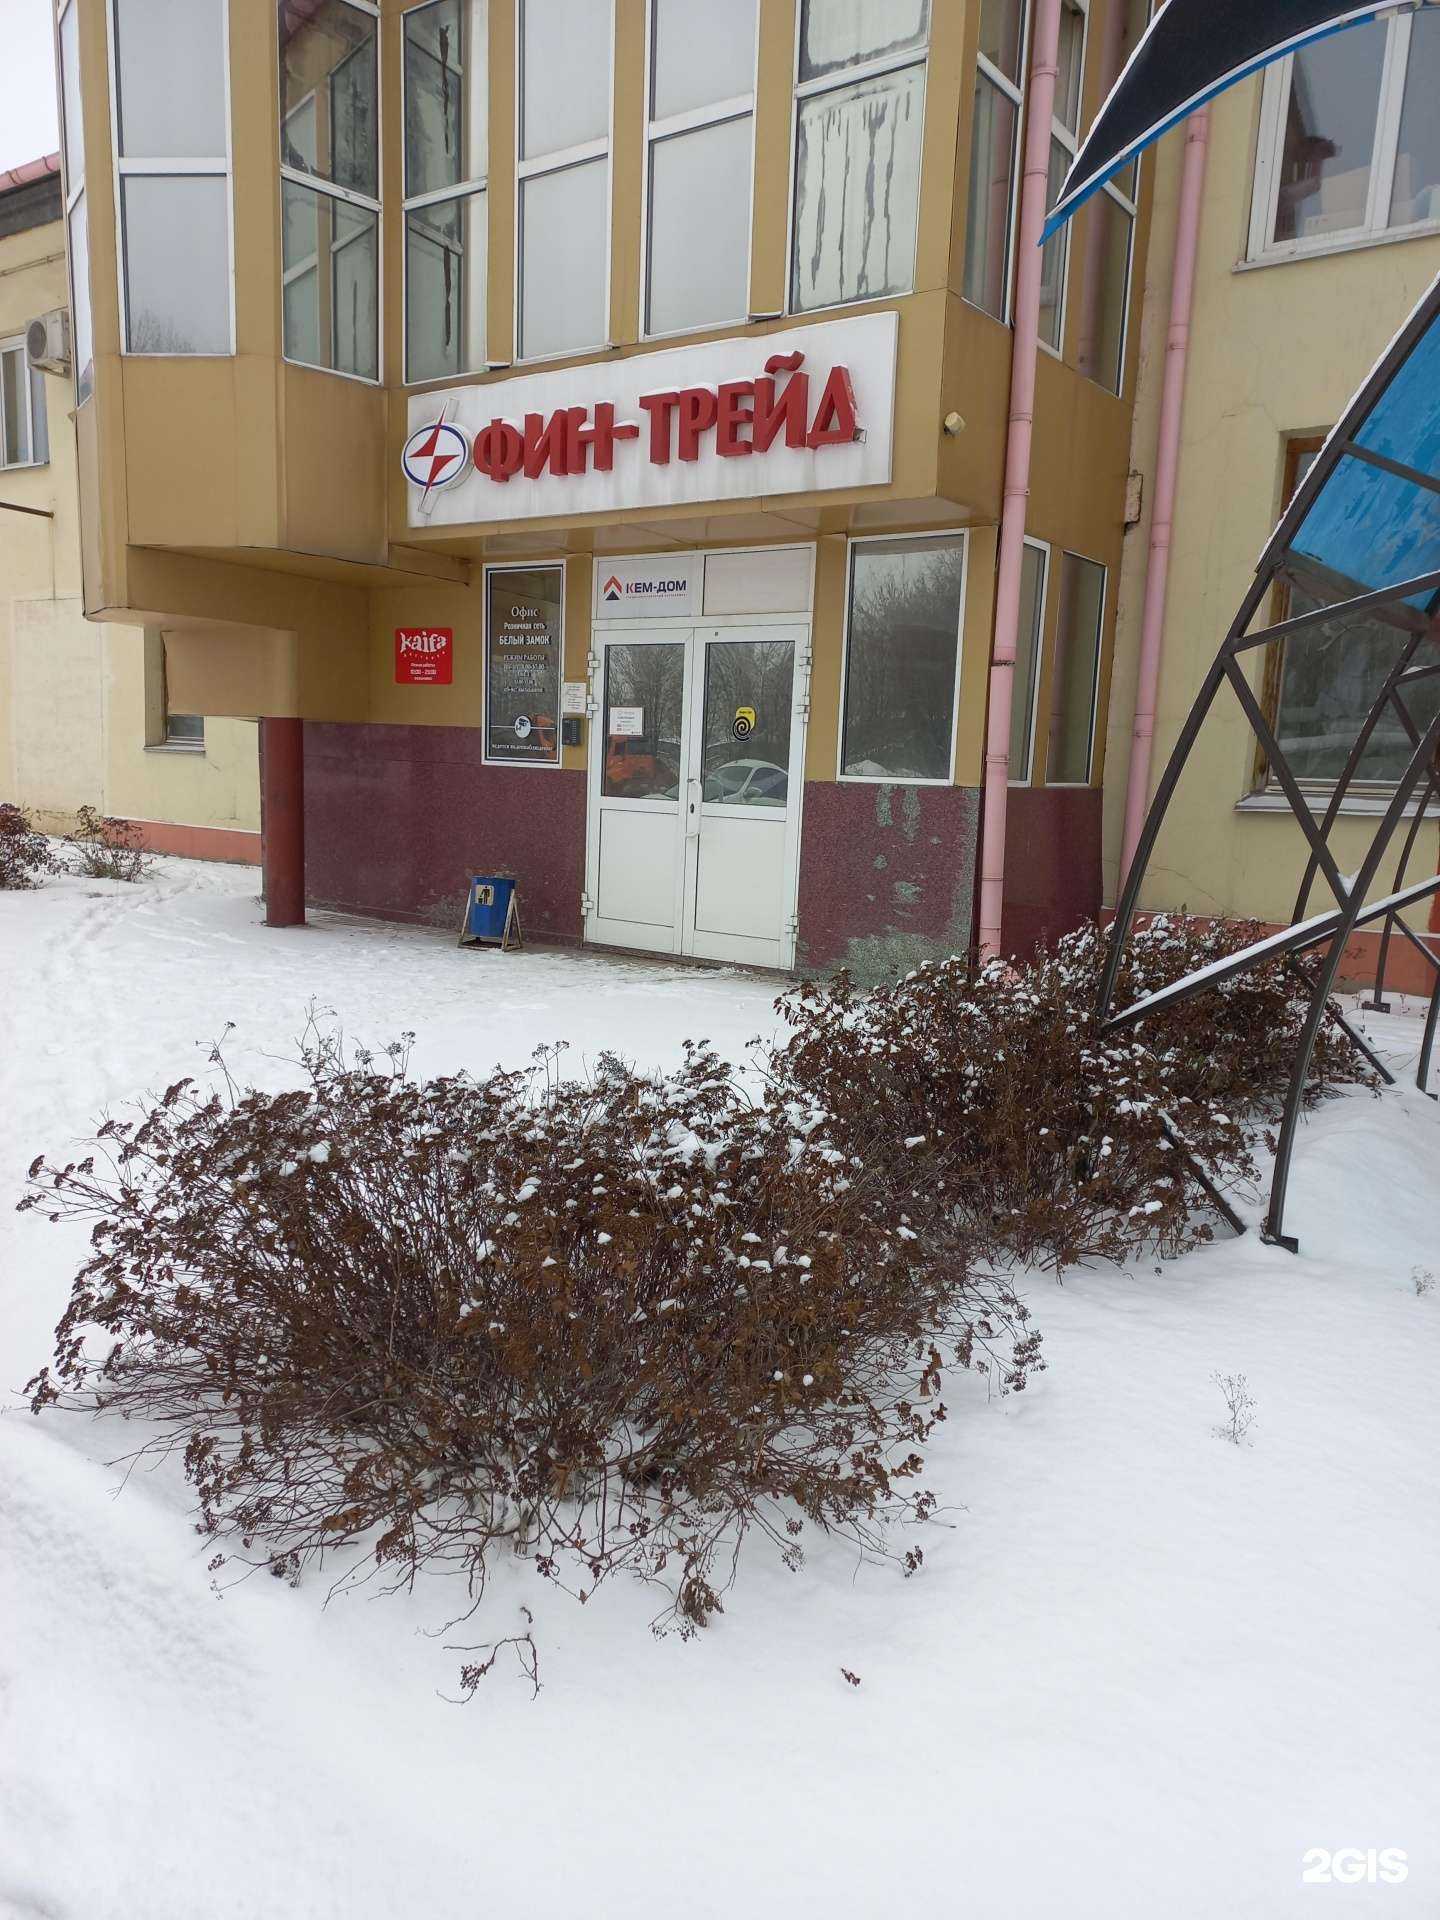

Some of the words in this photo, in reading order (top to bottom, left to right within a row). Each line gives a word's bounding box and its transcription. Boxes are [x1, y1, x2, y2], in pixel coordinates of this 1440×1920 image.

[473, 351, 858, 482] ФИН-ТРЕЙД
[626, 580, 687, 594] КЕМ-ДОМ
[511, 605, 539, 621] Офис
[503, 622, 532, 630] Розничная
[533, 622, 546, 630] сеть
[499, 633, 525, 645] БЕЛЫЙ
[526, 635, 550, 645] ЗАМОК
